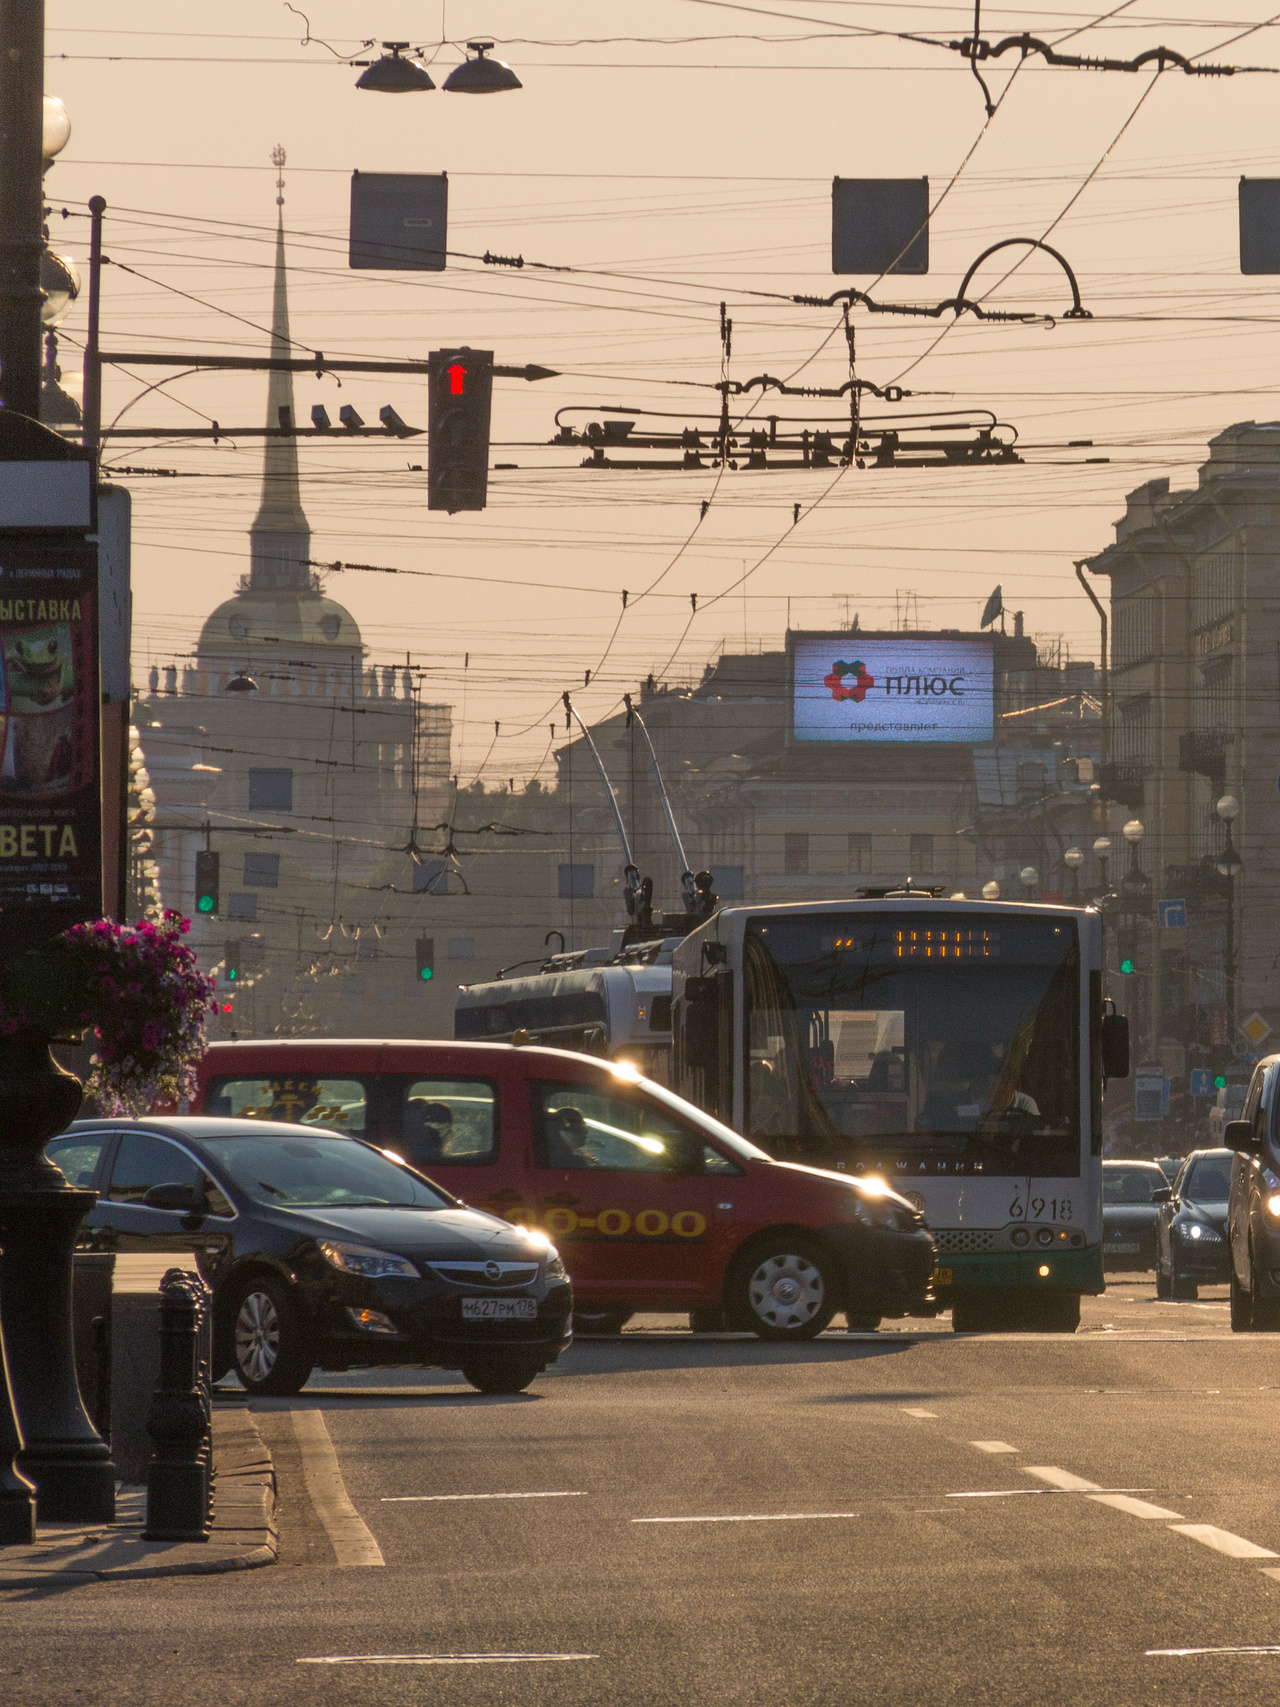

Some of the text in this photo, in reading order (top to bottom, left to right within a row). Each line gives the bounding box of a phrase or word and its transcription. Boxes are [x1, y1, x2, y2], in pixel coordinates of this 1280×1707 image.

[885, 676, 965, 695] ПЛЮС
[850, 722, 938, 733] представляет
[1008, 1196, 1074, 1221] 6918
